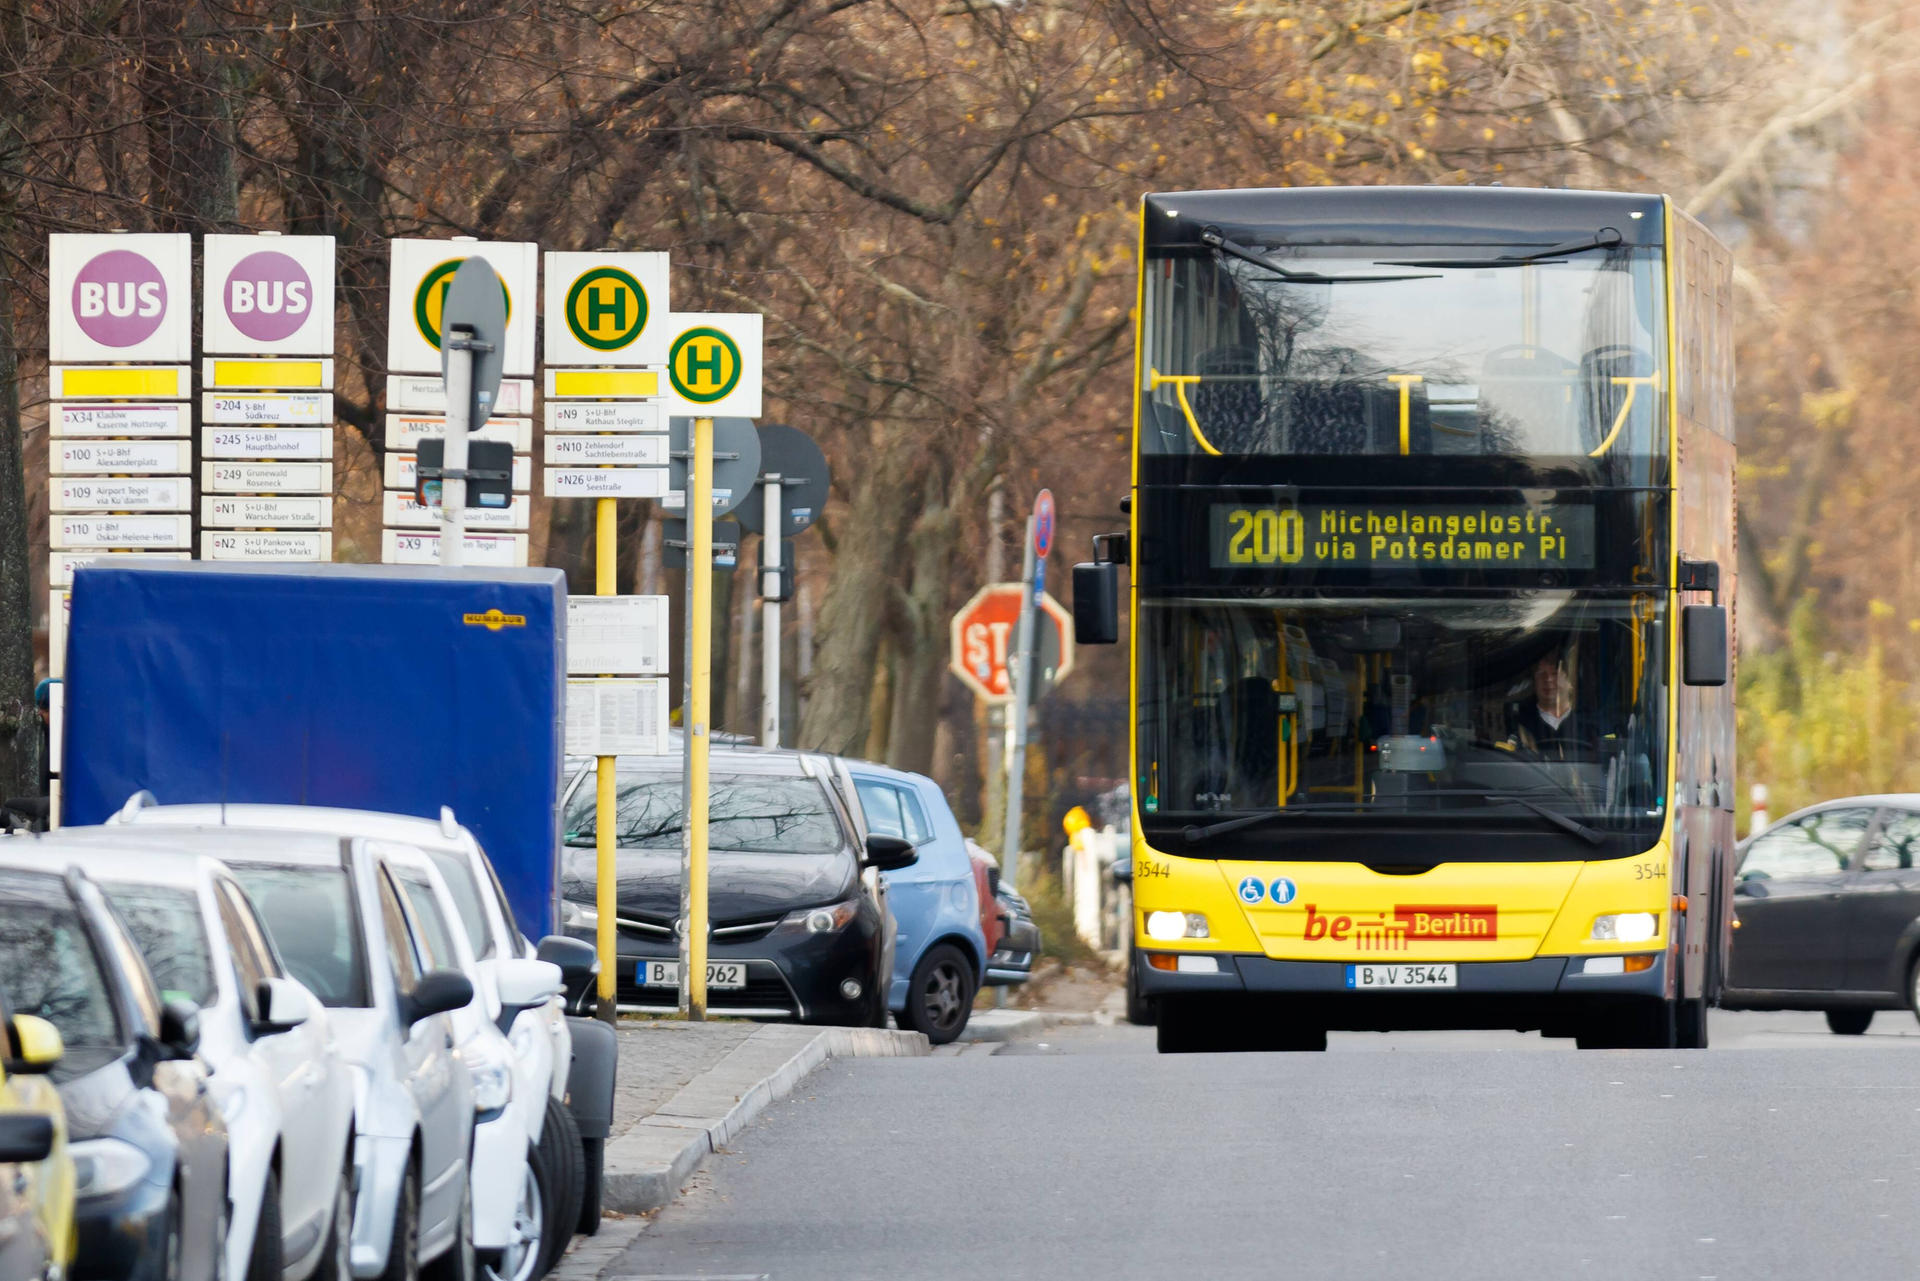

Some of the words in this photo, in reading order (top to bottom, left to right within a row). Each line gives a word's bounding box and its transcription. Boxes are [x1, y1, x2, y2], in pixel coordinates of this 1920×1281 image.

[80, 282, 162, 317] BUS
[231, 280, 307, 314] BUS
[588, 287, 626, 331] H
[687, 345, 721, 385] H
[222, 400, 241, 411] 204
[71, 412, 93, 423] X34
[564, 409, 577, 419] N9
[222, 434, 241, 445] 245
[245, 443, 299, 452] Hauptbahnhof
[562, 442, 582, 452] N10
[72, 449, 91, 460] 100
[96, 458, 157, 467] Alexanderplatz
[223, 469, 242, 480] 249
[564, 475, 584, 485] N26
[72, 487, 91, 498] 109
[96, 487, 125, 496] Airport
[128, 486, 149, 496] Tegel
[222, 503, 235, 514] N1
[1320, 509, 1562, 535] Michelangelostr.
[72, 524, 89, 535] 110
[1229, 509, 1304, 563] 200
[221, 538, 236, 549] N2
[406, 538, 421, 550] X9
[1315, 535, 1356, 559] via
[1371, 535, 1525, 559] Potsdamer
[1540, 535, 1566, 559] Pl
[966, 622, 1010, 664] ST
[1138, 861, 1171, 878] 3544
[1304, 904, 1351, 941] be
[1414, 913, 1488, 935] Berlin
[654, 964, 664, 981] B
[1363, 968, 1374, 985] B
[1387, 968, 1398, 985] V
[1404, 967, 1448, 984] 3544
